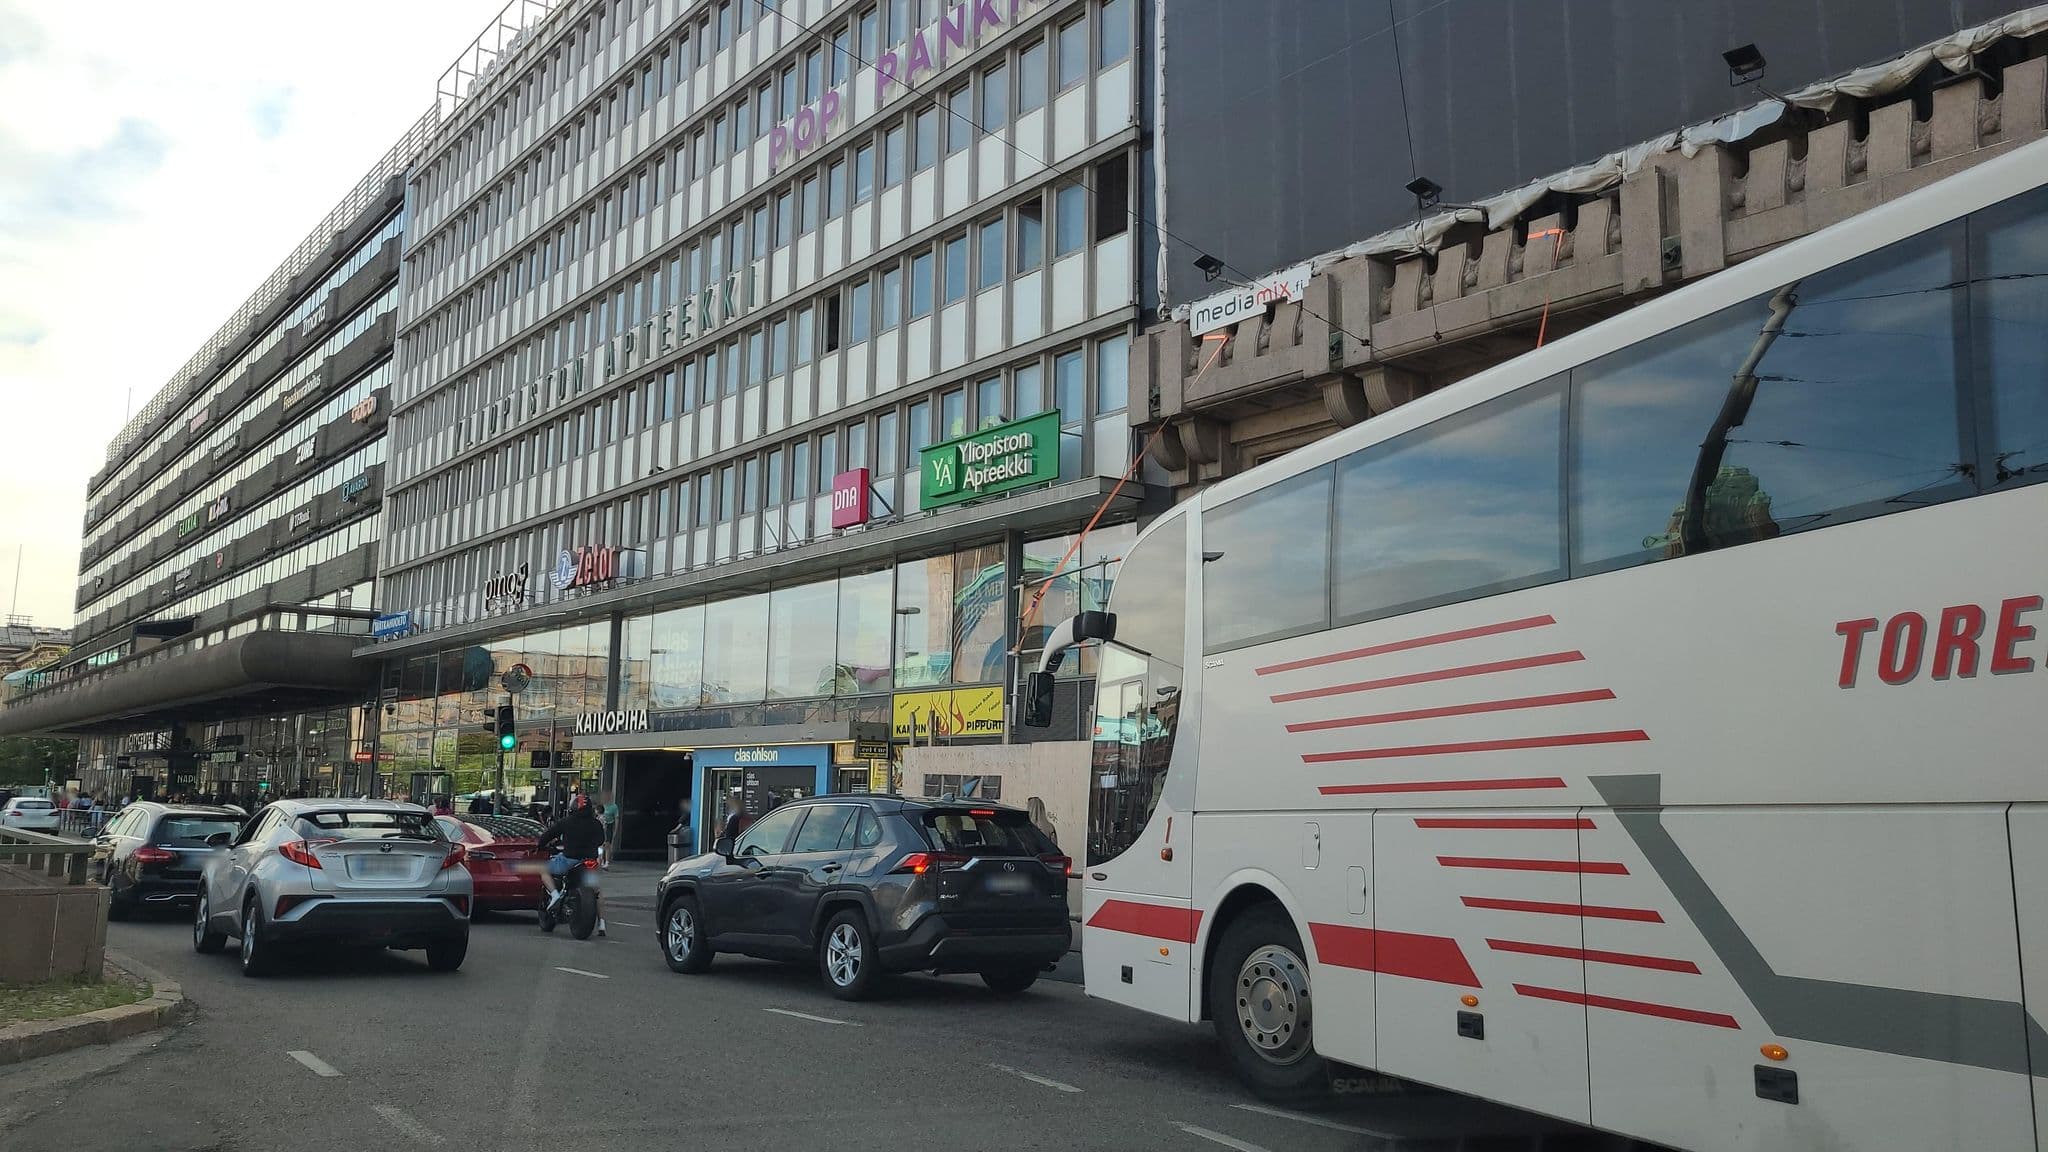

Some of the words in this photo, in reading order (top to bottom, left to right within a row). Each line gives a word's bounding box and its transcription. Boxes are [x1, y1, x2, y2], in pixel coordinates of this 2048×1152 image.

[769, 90, 839, 170] POP
[604, 264, 757, 378] APTEEKKI
[1196, 280, 1303, 330] mediamix.fi
[959, 431, 1032, 465] Yliopiston
[932, 457, 953, 487] YA
[962, 457, 1032, 493] Apteekki
[834, 486, 857, 511] DNA
[575, 544, 617, 586] Zetor
[1835, 594, 2048, 690] TORE
[575, 708, 649, 735] KAIVOPIHA
[734, 747, 751, 762] clas
[751, 746, 779, 762] ohlson
[1332, 1078, 1404, 1096] SCANIA
